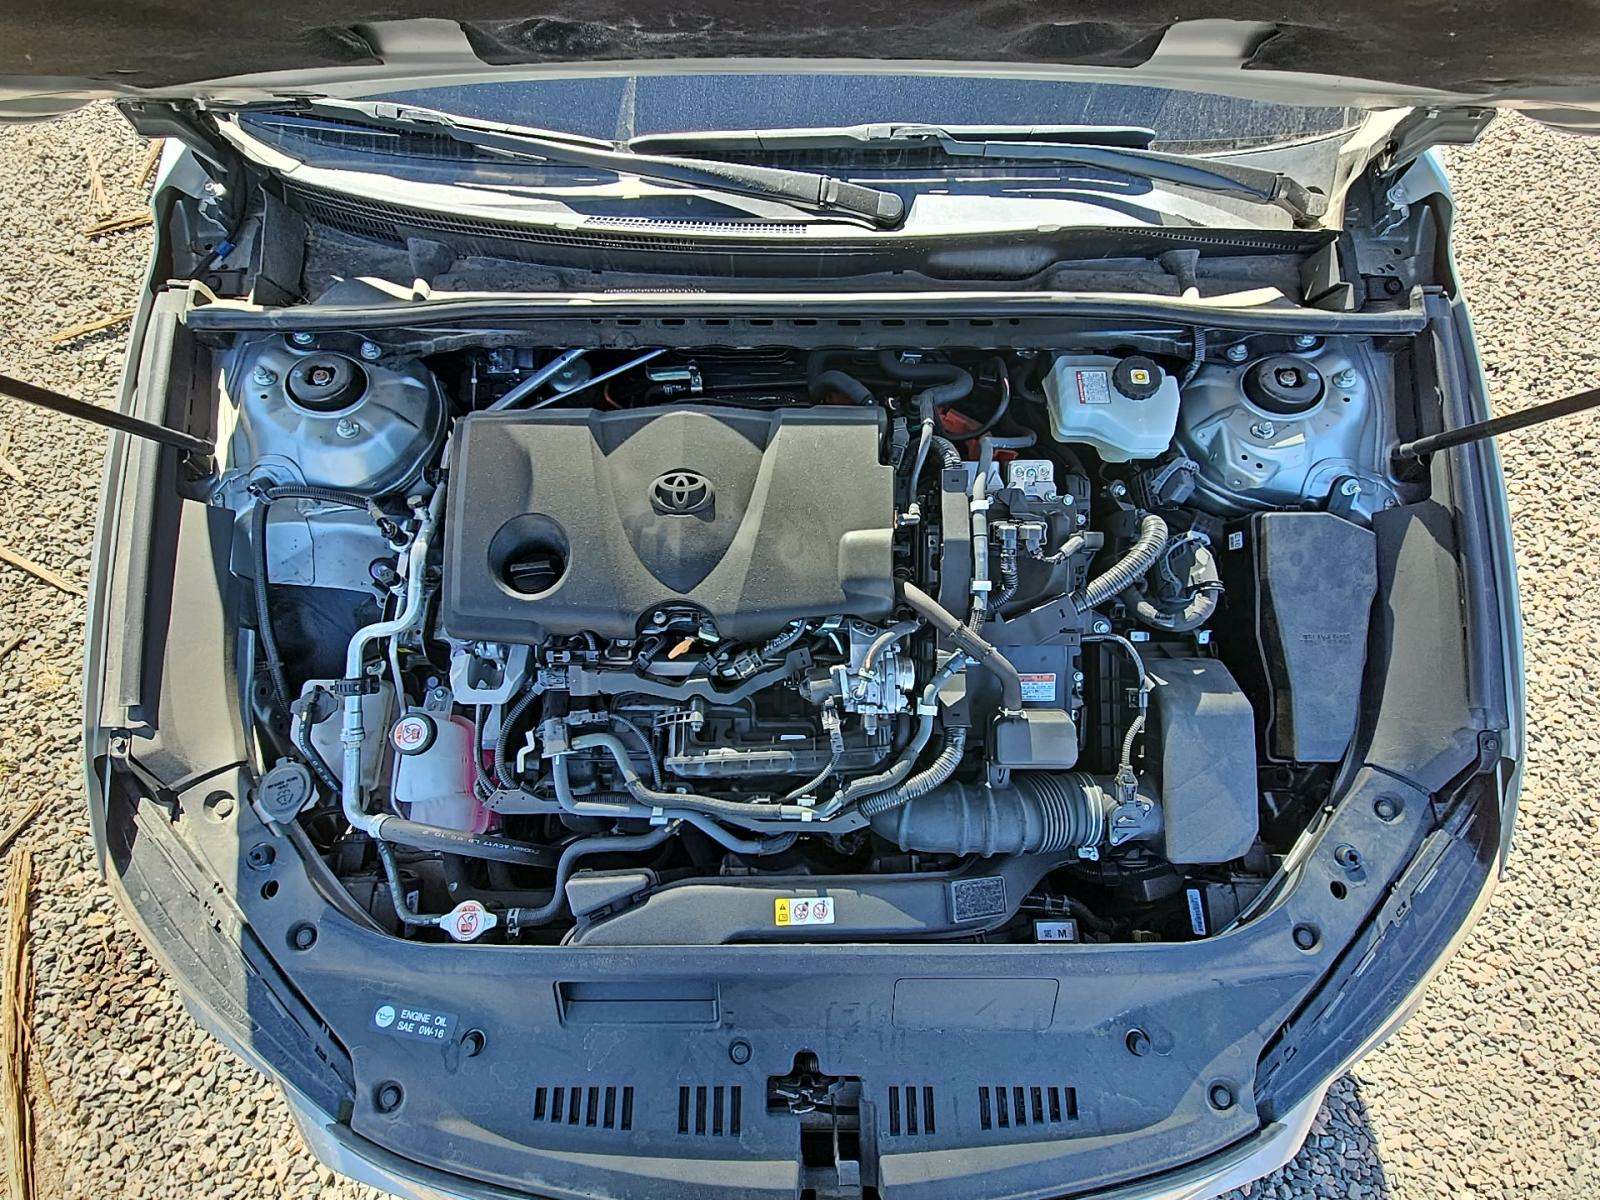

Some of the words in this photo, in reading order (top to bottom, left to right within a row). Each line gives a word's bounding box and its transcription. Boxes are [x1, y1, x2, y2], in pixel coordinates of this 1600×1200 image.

[400, 1009, 431, 1024] ENGINE
[434, 1015, 448, 1027] OIL
[397, 1020, 415, 1033] SAE
[418, 1025, 445, 1039] 0W-16
